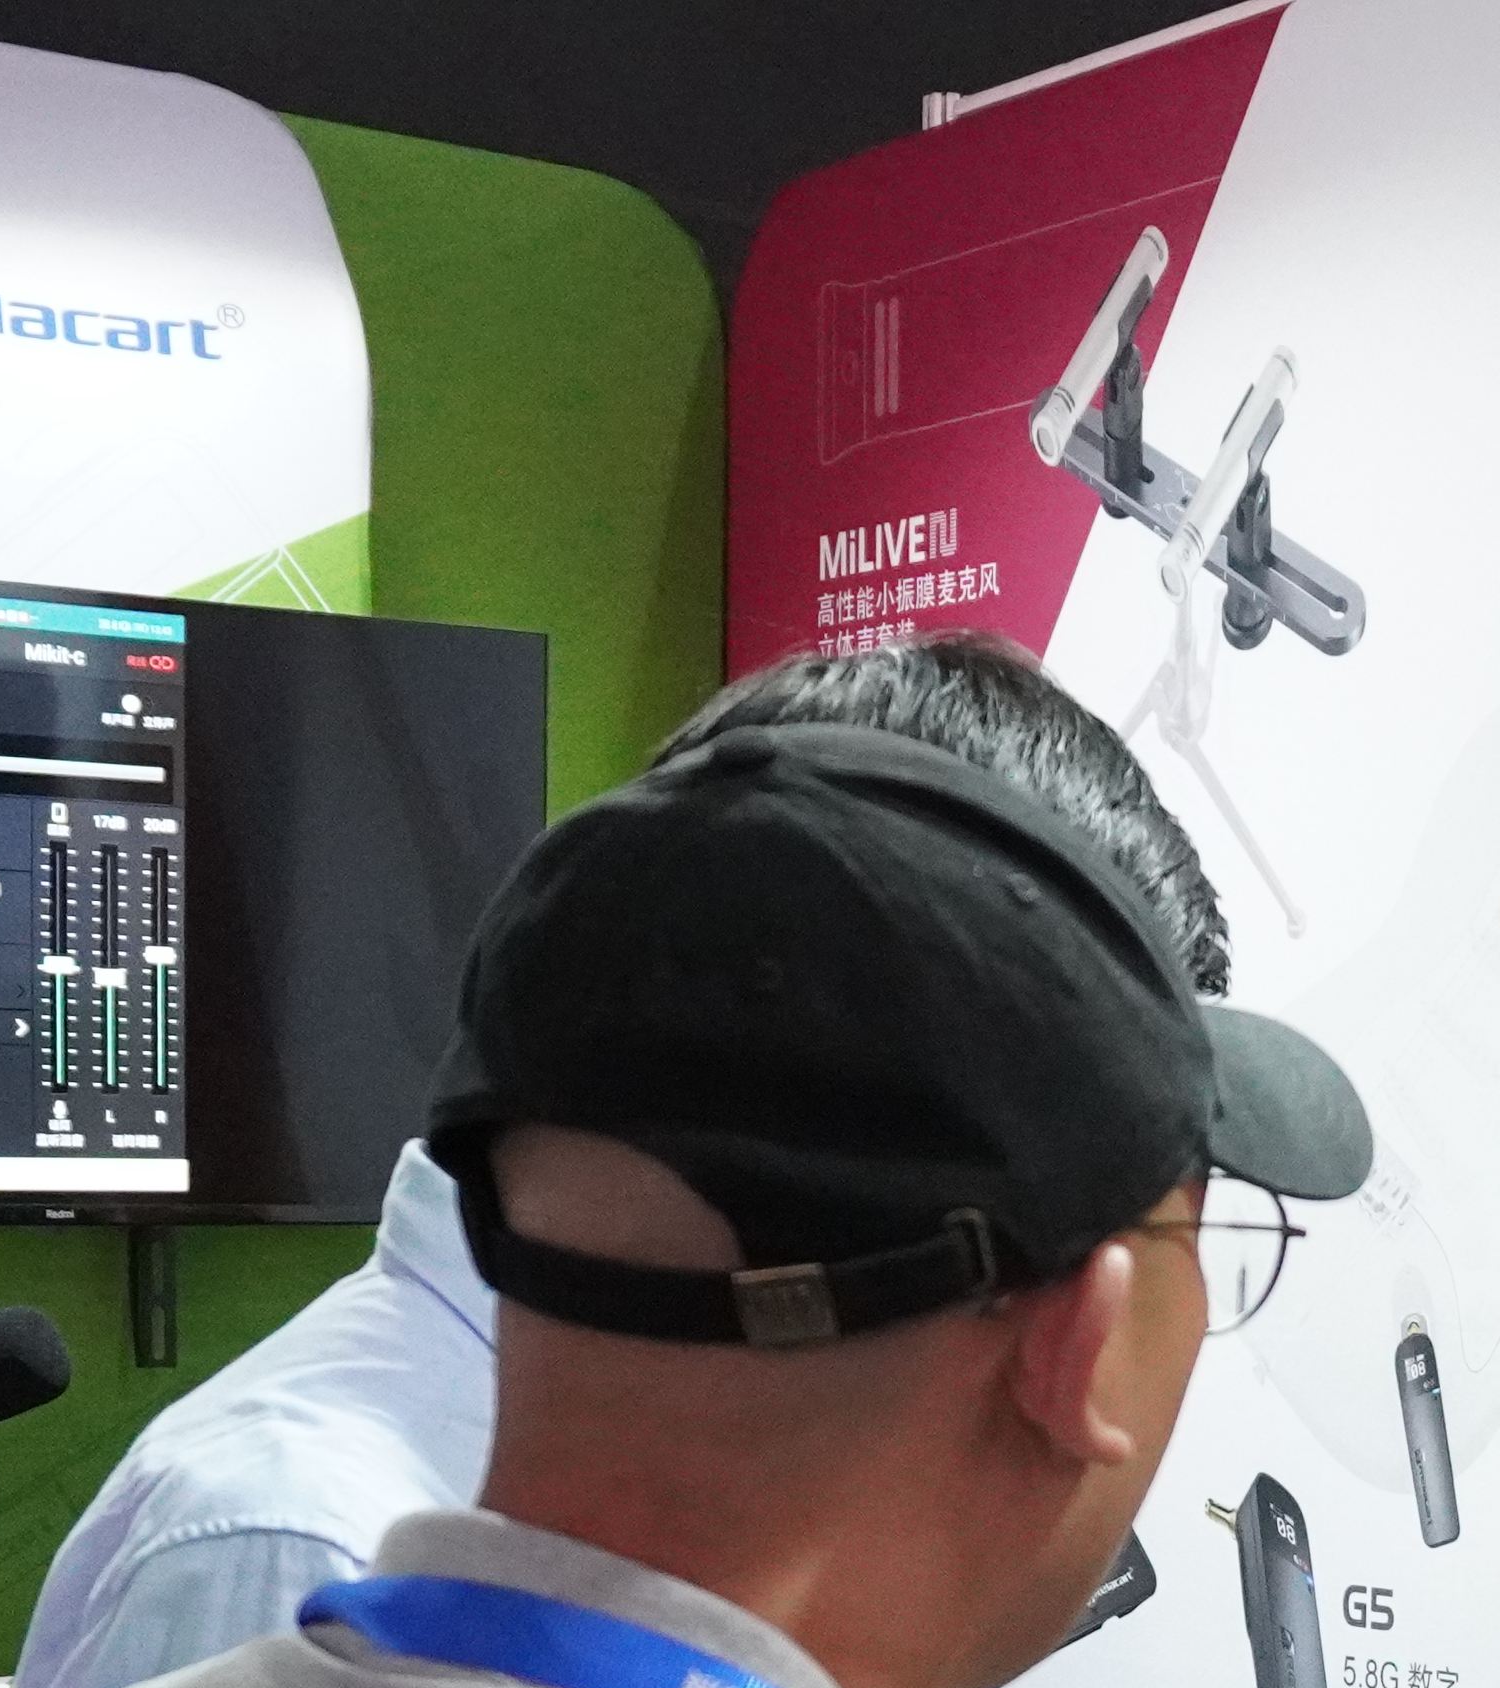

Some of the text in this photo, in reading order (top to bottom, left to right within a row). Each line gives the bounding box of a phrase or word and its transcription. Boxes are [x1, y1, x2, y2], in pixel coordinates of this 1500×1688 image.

[816, 561, 1000, 628] 高性能小振膜麦克风
[1342, 1584, 1395, 1631] G5
